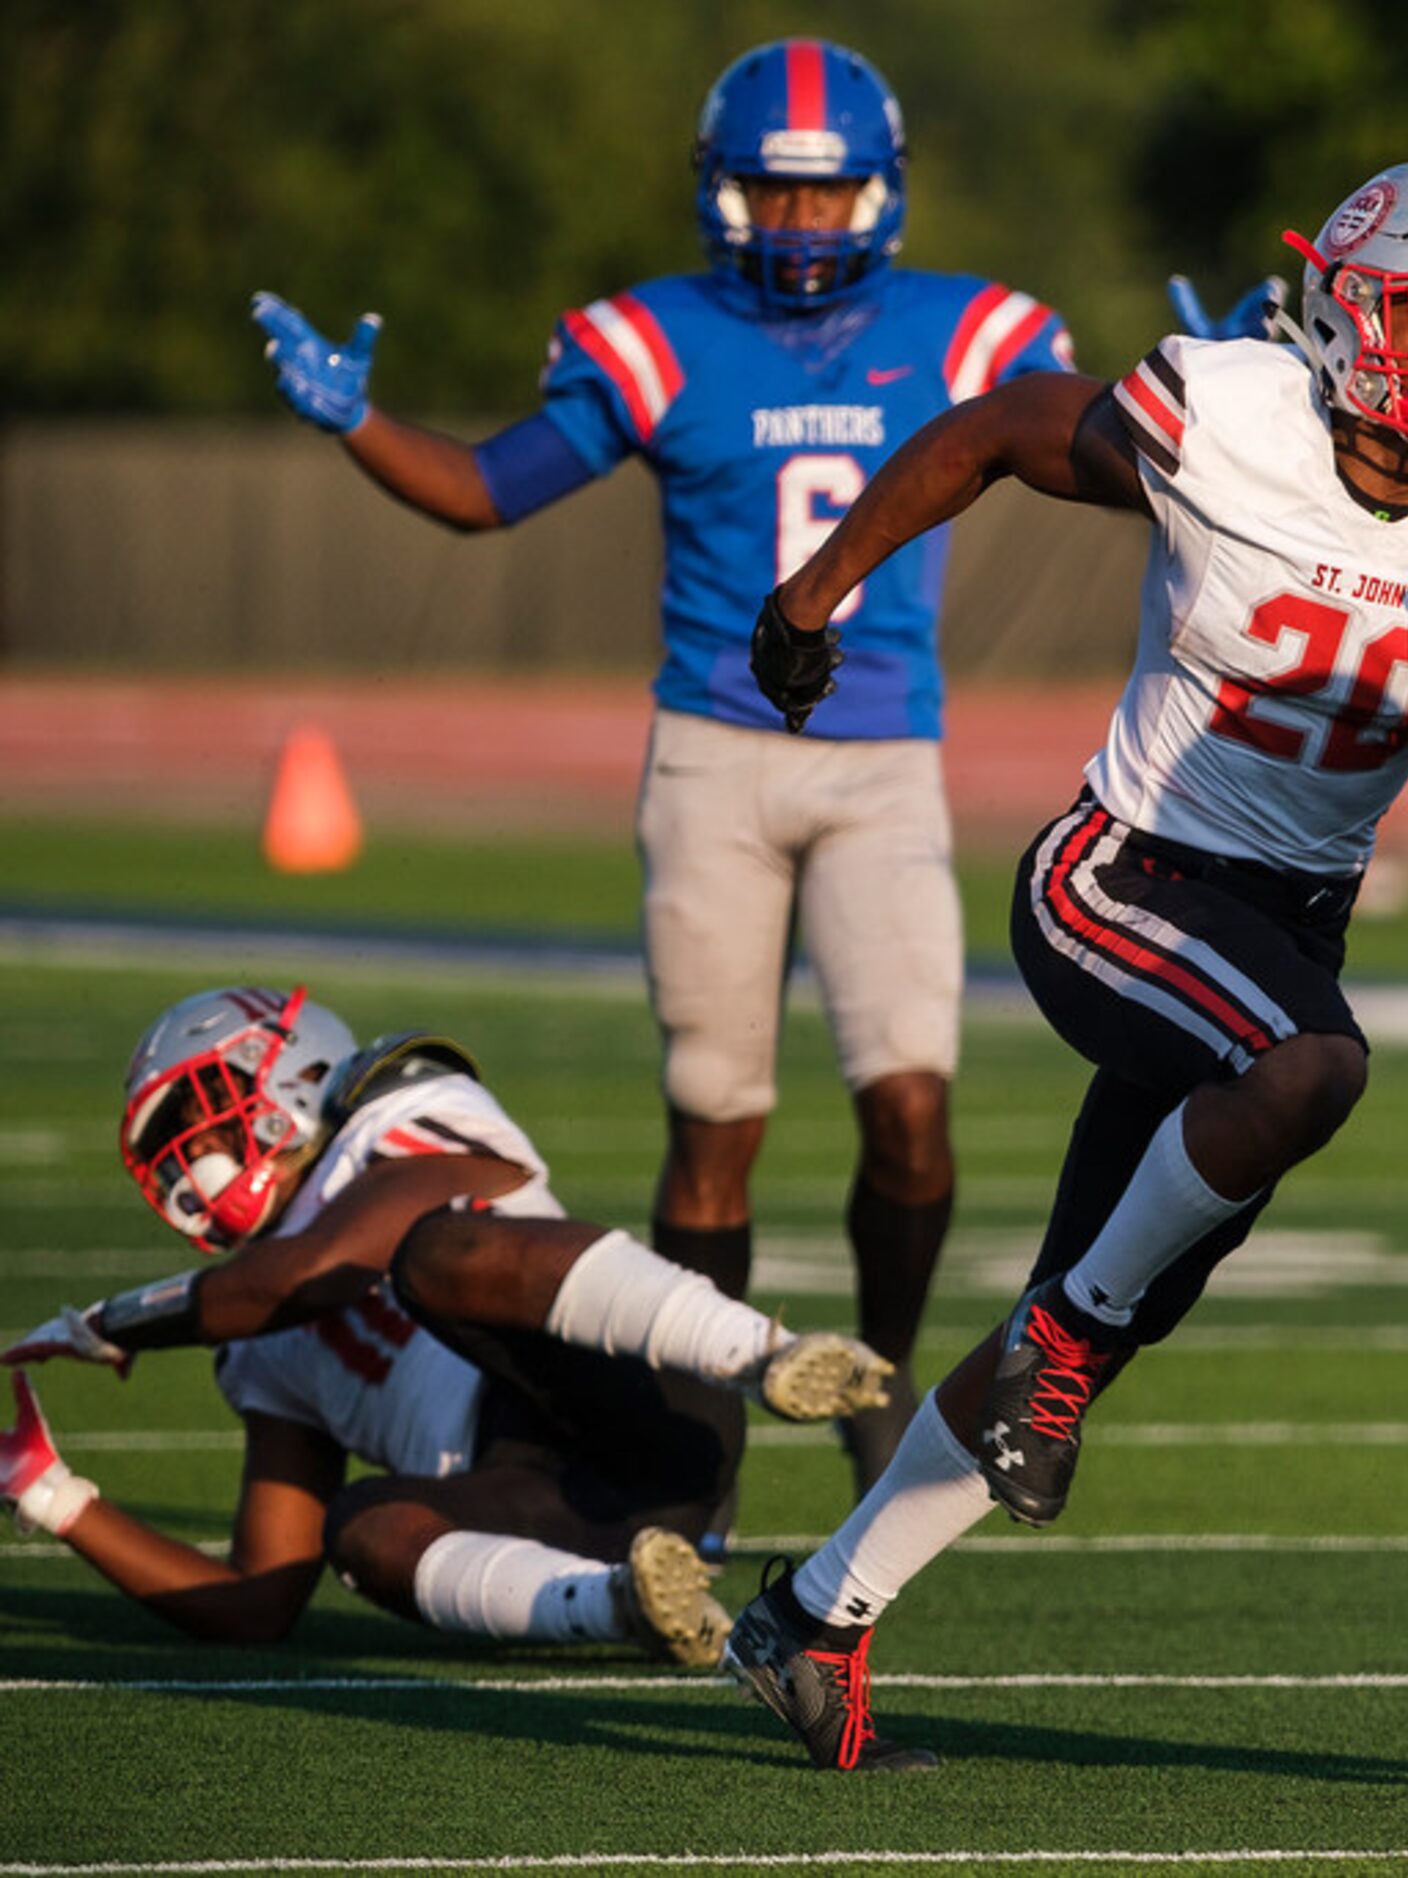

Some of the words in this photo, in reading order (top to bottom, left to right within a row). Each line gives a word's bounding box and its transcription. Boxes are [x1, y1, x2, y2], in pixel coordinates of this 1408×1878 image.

[752, 404, 886, 448] PANTHERS
[775, 453, 866, 624] 6
[1311, 563, 1343, 594] ST.
